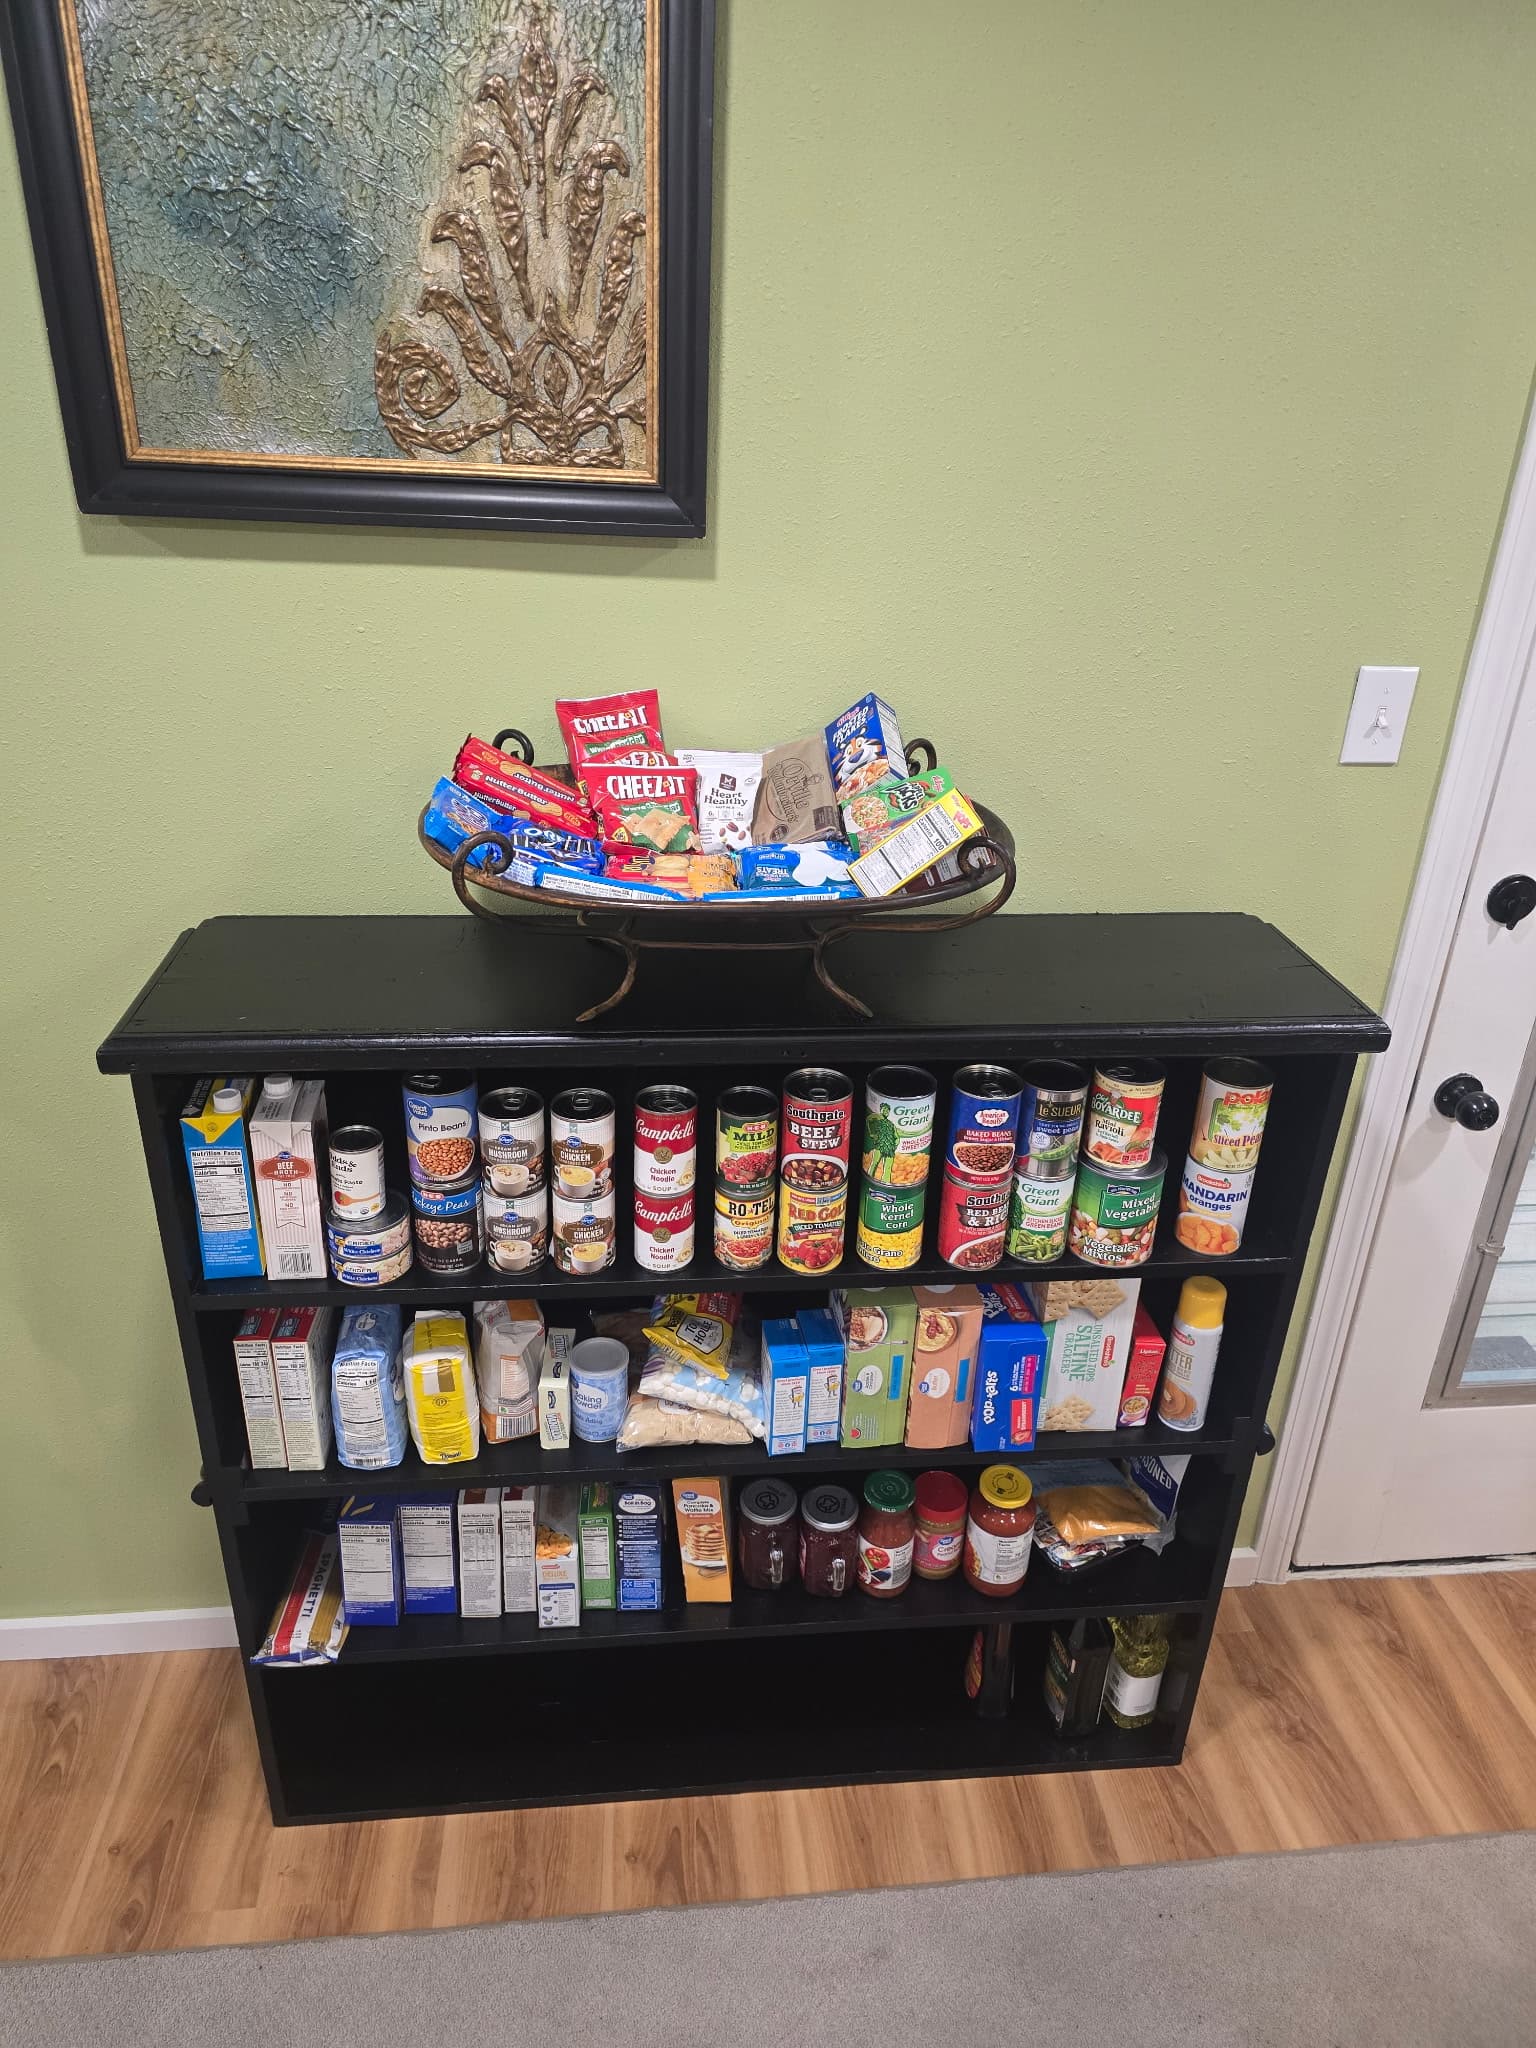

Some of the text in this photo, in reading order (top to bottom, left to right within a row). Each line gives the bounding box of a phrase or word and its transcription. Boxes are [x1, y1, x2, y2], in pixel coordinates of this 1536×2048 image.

[832, 706, 869, 743] FROSTED
[835, 718, 868, 747] FLAKES
[485, 775, 548, 805] Nutter Butter
[711, 787, 742, 799] Heart
[704, 795, 748, 806] Healthy
[884, 784, 919, 810] JACKS
[917, 818, 945, 851] Calories 100
[407, 1100, 428, 1112] Great
[412, 1107, 428, 1117] Value
[893, 1104, 930, 1116] Green
[1039, 1103, 1082, 1118] Le SUEUR
[1092, 1100, 1142, 1124] BOYARDEE
[786, 1104, 845, 1123] Southgate
[418, 1121, 467, 1132] Pinto Beans
[897, 1115, 929, 1127] Giant
[1103, 1119, 1117, 1127] Mini
[635, 1117, 695, 1142] Campbell's
[790, 1122, 836, 1139] BEEF
[966, 1130, 990, 1138] BAKED
[1036, 1126, 1061, 1134] sweet
[1096, 1120, 1124, 1136] Ravioli
[733, 1128, 775, 1142] MILD
[1213, 1134, 1241, 1147] Sliced
[802, 1137, 841, 1150] STEW
[330, 1153, 348, 1165] dds
[488, 1148, 528, 1158] MUSHROOM
[560, 1151, 591, 1161] CHICKEN
[194, 1168, 218, 1176] Calories
[277, 1162, 294, 1170] BEEF
[650, 1166, 677, 1176] Chicken
[650, 1174, 675, 1183] Noodle
[1021, 1183, 1060, 1196] Green
[1182, 1174, 1248, 1203] MANDARIN
[445, 1199, 470, 1211] Peas
[1024, 1195, 1059, 1206] Giant
[1122, 1191, 1156, 1209] Mixed
[1189, 1194, 1232, 1211] oranges
[635, 1197, 693, 1223] Campbell's
[788, 1203, 817, 1221] RED
[818, 1200, 846, 1221] GOL
[881, 1203, 914, 1213] Whole
[966, 1203, 1010, 1217] RED BEA
[880, 1210, 914, 1221] Kernel
[967, 1213, 1009, 1227] & RIC
[734, 1216, 769, 1228] Original
[794, 1224, 813, 1232] DICED
[886, 1221, 908, 1229] Corn
[493, 1225, 531, 1235] MUSHROOM
[573, 1229, 604, 1239] CHICKEN
[649, 1246, 675, 1254] Chicken
[1084, 1236, 1140, 1253] Vegetales
[650, 1253, 674, 1261] Noodle
[873, 1247, 903, 1257] Grano
[1083, 1246, 1123, 1262] Mixtos
[1060, 1332, 1075, 1374] CRACKERS
[1069, 1325, 1093, 1382] SALTINE
[1085, 1324, 1104, 1383] UNSALTED TOPS
[1169, 1348, 1193, 1371] TTER
[439, 1451, 462, 1461] Domino
[301, 1552, 332, 1618] SPAGHETTI
